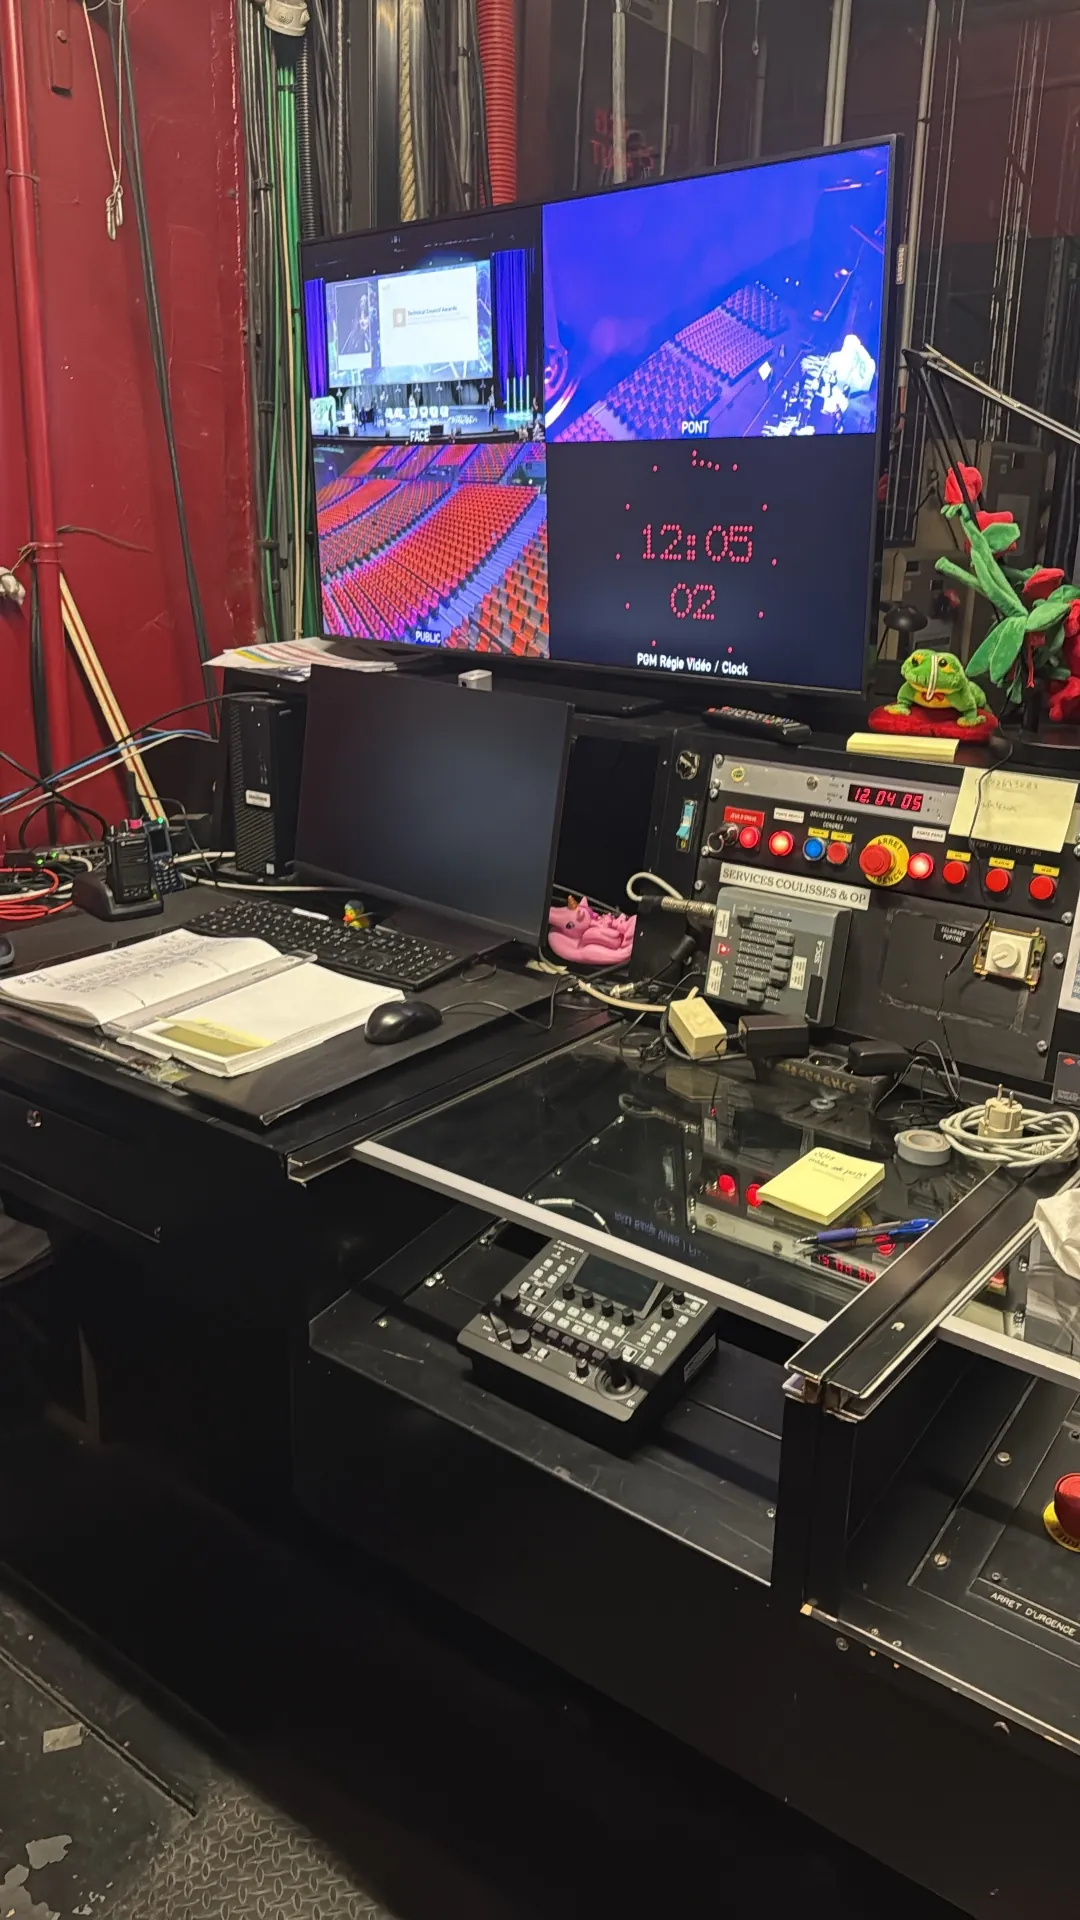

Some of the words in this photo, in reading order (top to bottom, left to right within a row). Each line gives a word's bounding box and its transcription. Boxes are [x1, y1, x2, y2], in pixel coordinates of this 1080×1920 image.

[410, 430, 429, 442] FACE
[682, 420, 709, 434] PONT
[642, 524, 753, 563] 12:05
[670, 583, 716, 620] 02
[416, 630, 441, 644] PUBLIC
[637, 652, 657, 667] PGM
[660, 654, 685, 671] Régie
[686, 657, 712, 672] Vidéo
[714, 660, 720, 673] /
[722, 661, 748, 676] Clock
[877, 837, 903, 851] ARRET
[722, 868, 774, 887] SERVICES
[775, 877, 837, 899] COULISSES
[838, 890, 848, 901] &
[850, 892, 866, 904] OP
[990, 1592, 1022, 1610] ARRET
[1024, 1607, 1077, 1637] D'URGENCE
